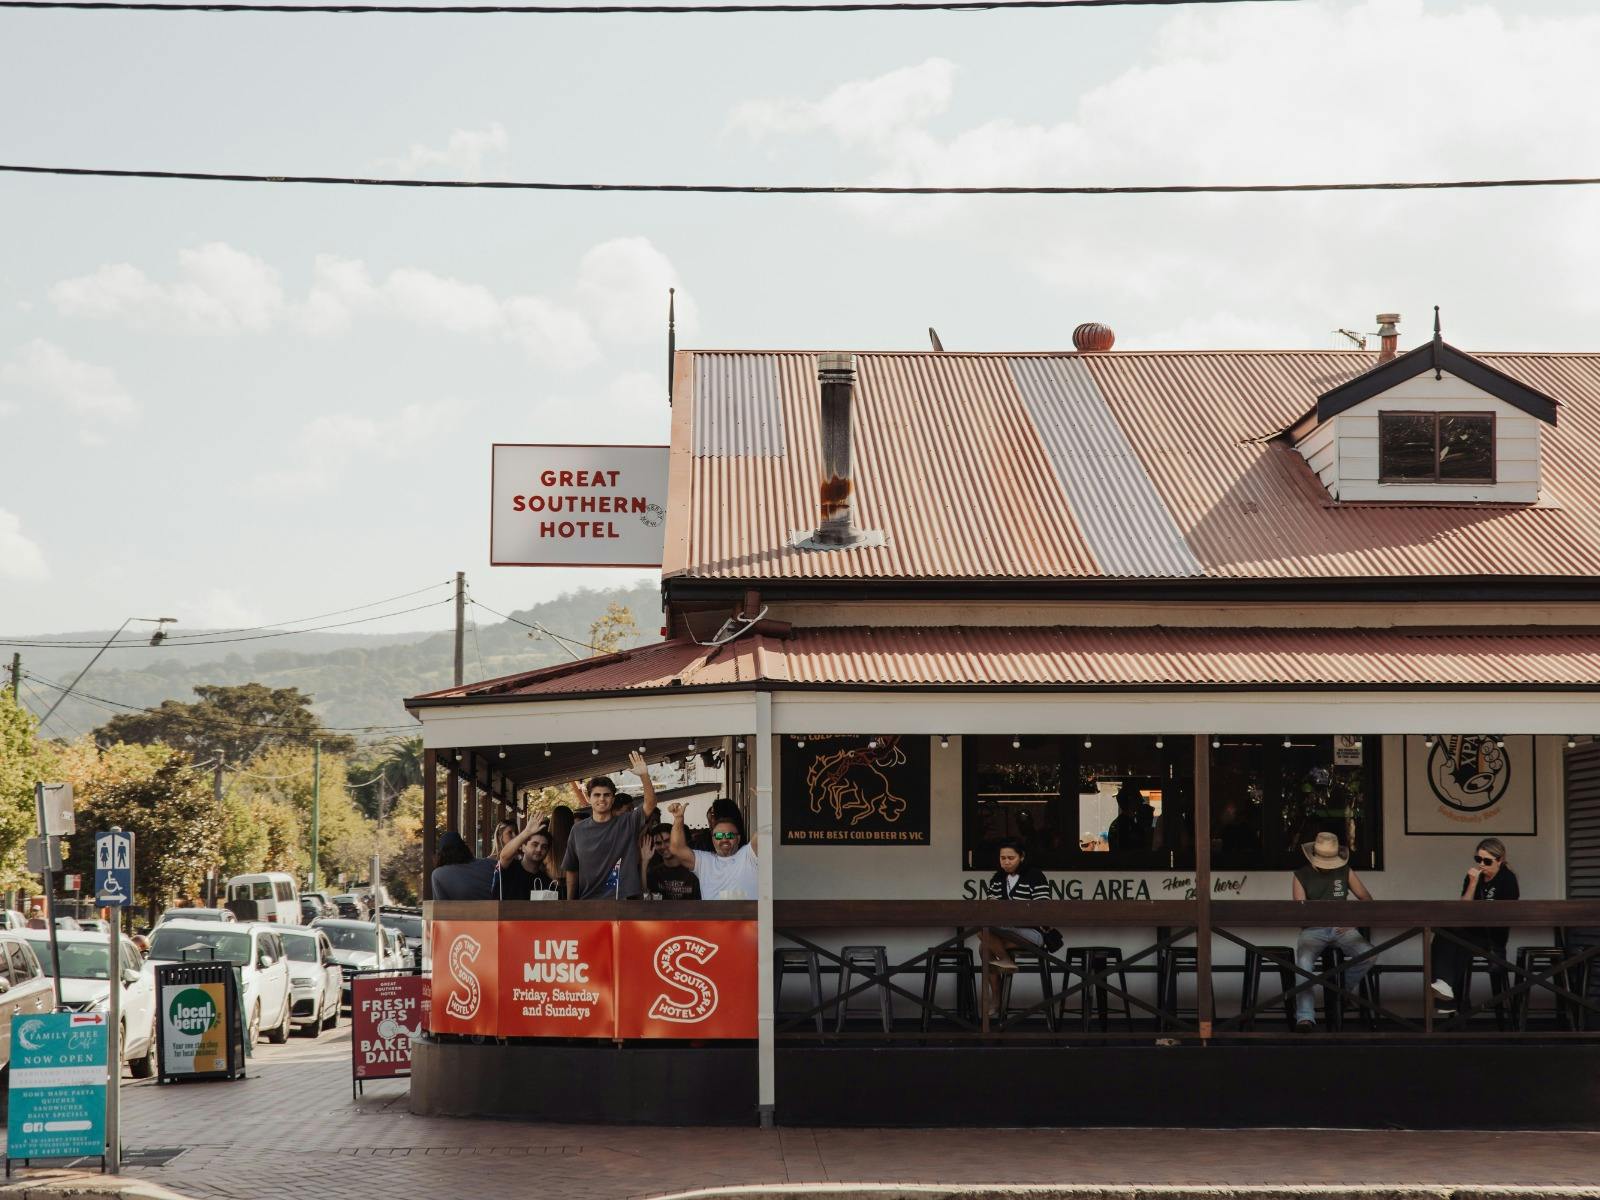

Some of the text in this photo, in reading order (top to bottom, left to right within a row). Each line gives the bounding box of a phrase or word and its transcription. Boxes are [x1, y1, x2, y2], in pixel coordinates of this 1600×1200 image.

[540, 470, 620, 487] GREAT
[513, 495, 646, 513] SOUTHERN
[540, 521, 620, 538] HOTEL
[1460, 735, 1479, 768] XPA
[788, 831, 924, 840] AND THE BEST COLD BEER IS VIC
[1093, 880, 1150, 900] AREA
[464, 940, 475, 954] THE
[534, 939, 578, 960] LIVE
[523, 963, 589, 983] MUSIC
[659, 941, 711, 1018] THE GREAT SOUTHERN HOTEL
[362, 998, 415, 1012] FRESH
[552, 988, 600, 1005] Saturday
[450, 1000, 470, 1014] HOTEL
[522, 1004, 590, 1020] and Sundays
[173, 1014, 211, 1033] berry
[371, 1010, 408, 1023] PIES
[30, 1031, 98, 1040] FAMILY TREE
[24, 1054, 94, 1065] NOW OPEN
